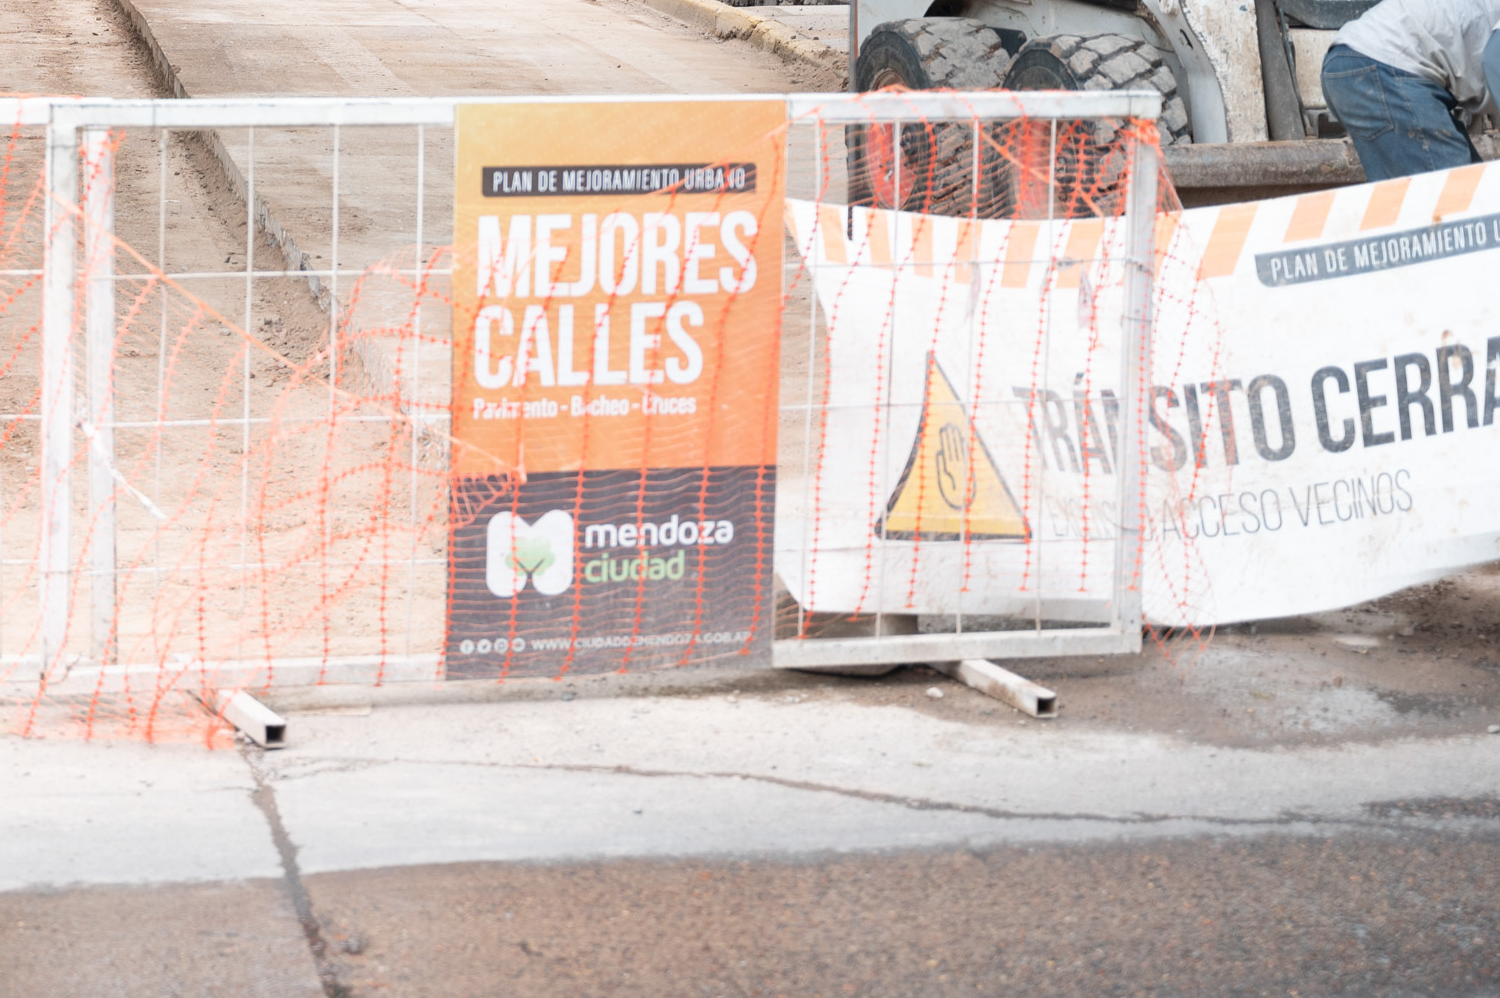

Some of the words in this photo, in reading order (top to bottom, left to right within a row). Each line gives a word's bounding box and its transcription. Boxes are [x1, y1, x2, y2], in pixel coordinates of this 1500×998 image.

[492, 169, 532, 193] PLAN
[538, 169, 557, 192] DE
[563, 167, 680, 192] MEJORAMIENTO
[476, 209, 759, 298] MEJORES
[1270, 252, 1319, 283] PLAN
[1324, 247, 1348, 274] DE
[1353, 221, 1488, 269] MEJORAMIENTO
[473, 300, 704, 390] CALLES
[584, 514, 735, 549] mendoza
[1161, 488, 1283, 541] ACCESO
[1288, 468, 1414, 529] VECINOS
[584, 549, 685, 584] ciudad
